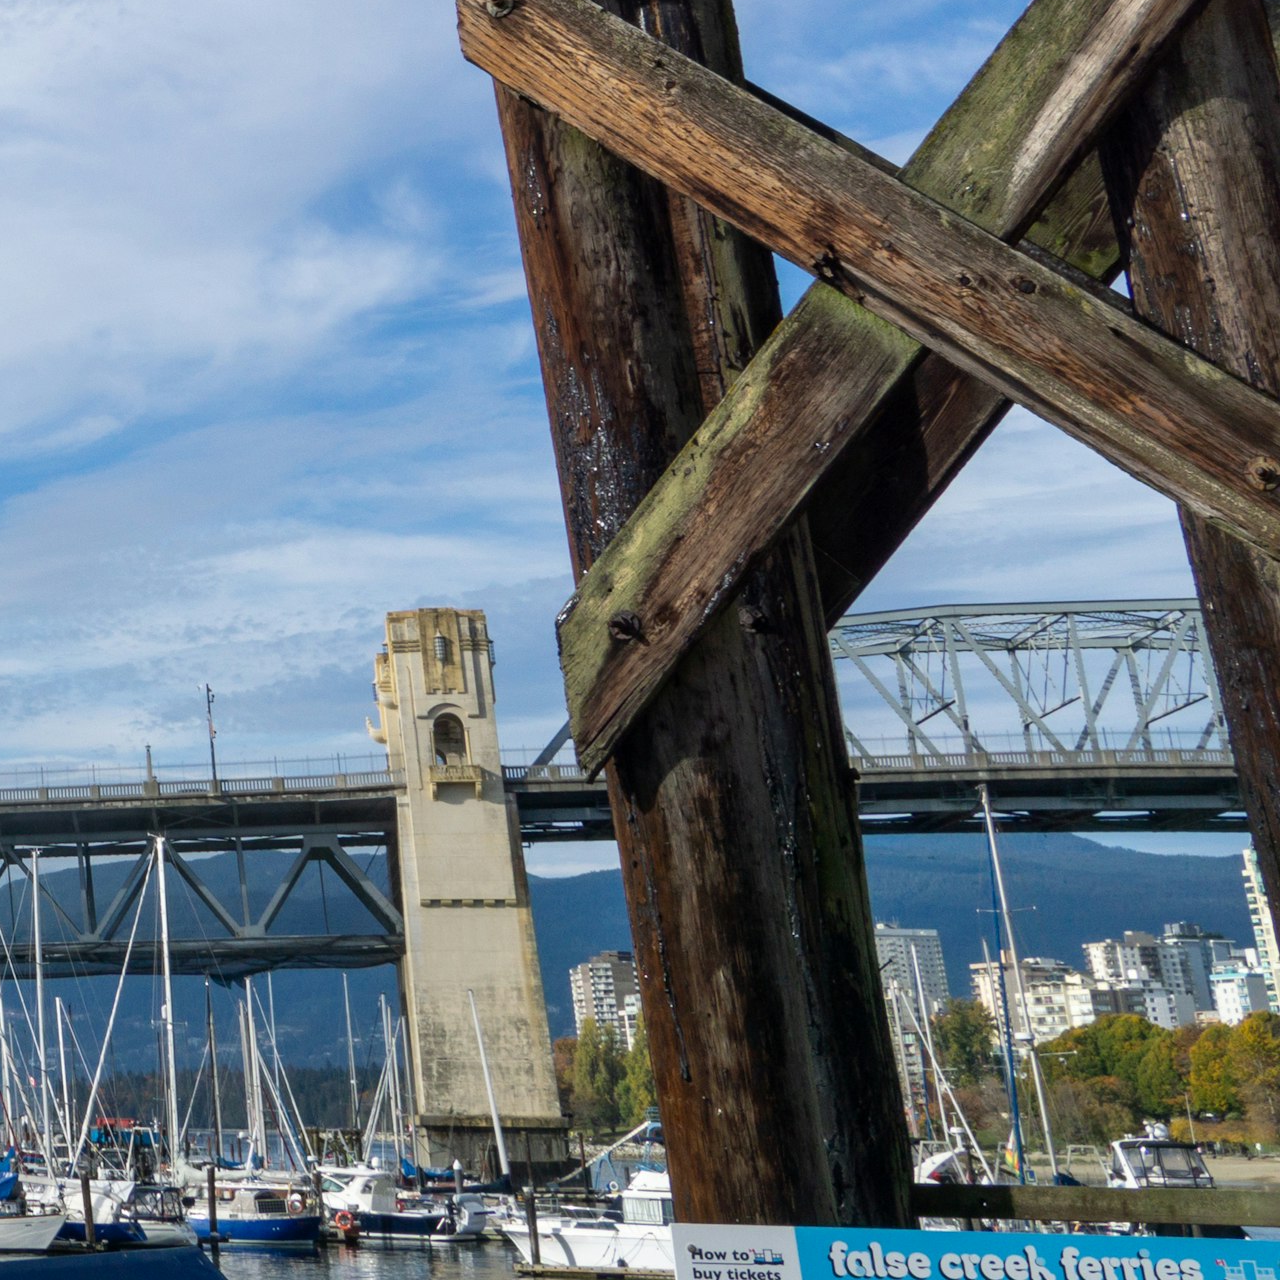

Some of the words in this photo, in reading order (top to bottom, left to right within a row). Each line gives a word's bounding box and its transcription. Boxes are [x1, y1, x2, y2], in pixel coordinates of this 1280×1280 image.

[691, 1248, 727, 1261] How
[732, 1250, 750, 1261] to
[828, 1241, 931, 1280] false
[938, 1245, 1055, 1280] creek
[1060, 1247, 1205, 1280] ferries
[693, 1268, 722, 1280] buy
[727, 1268, 782, 1280] tickets
